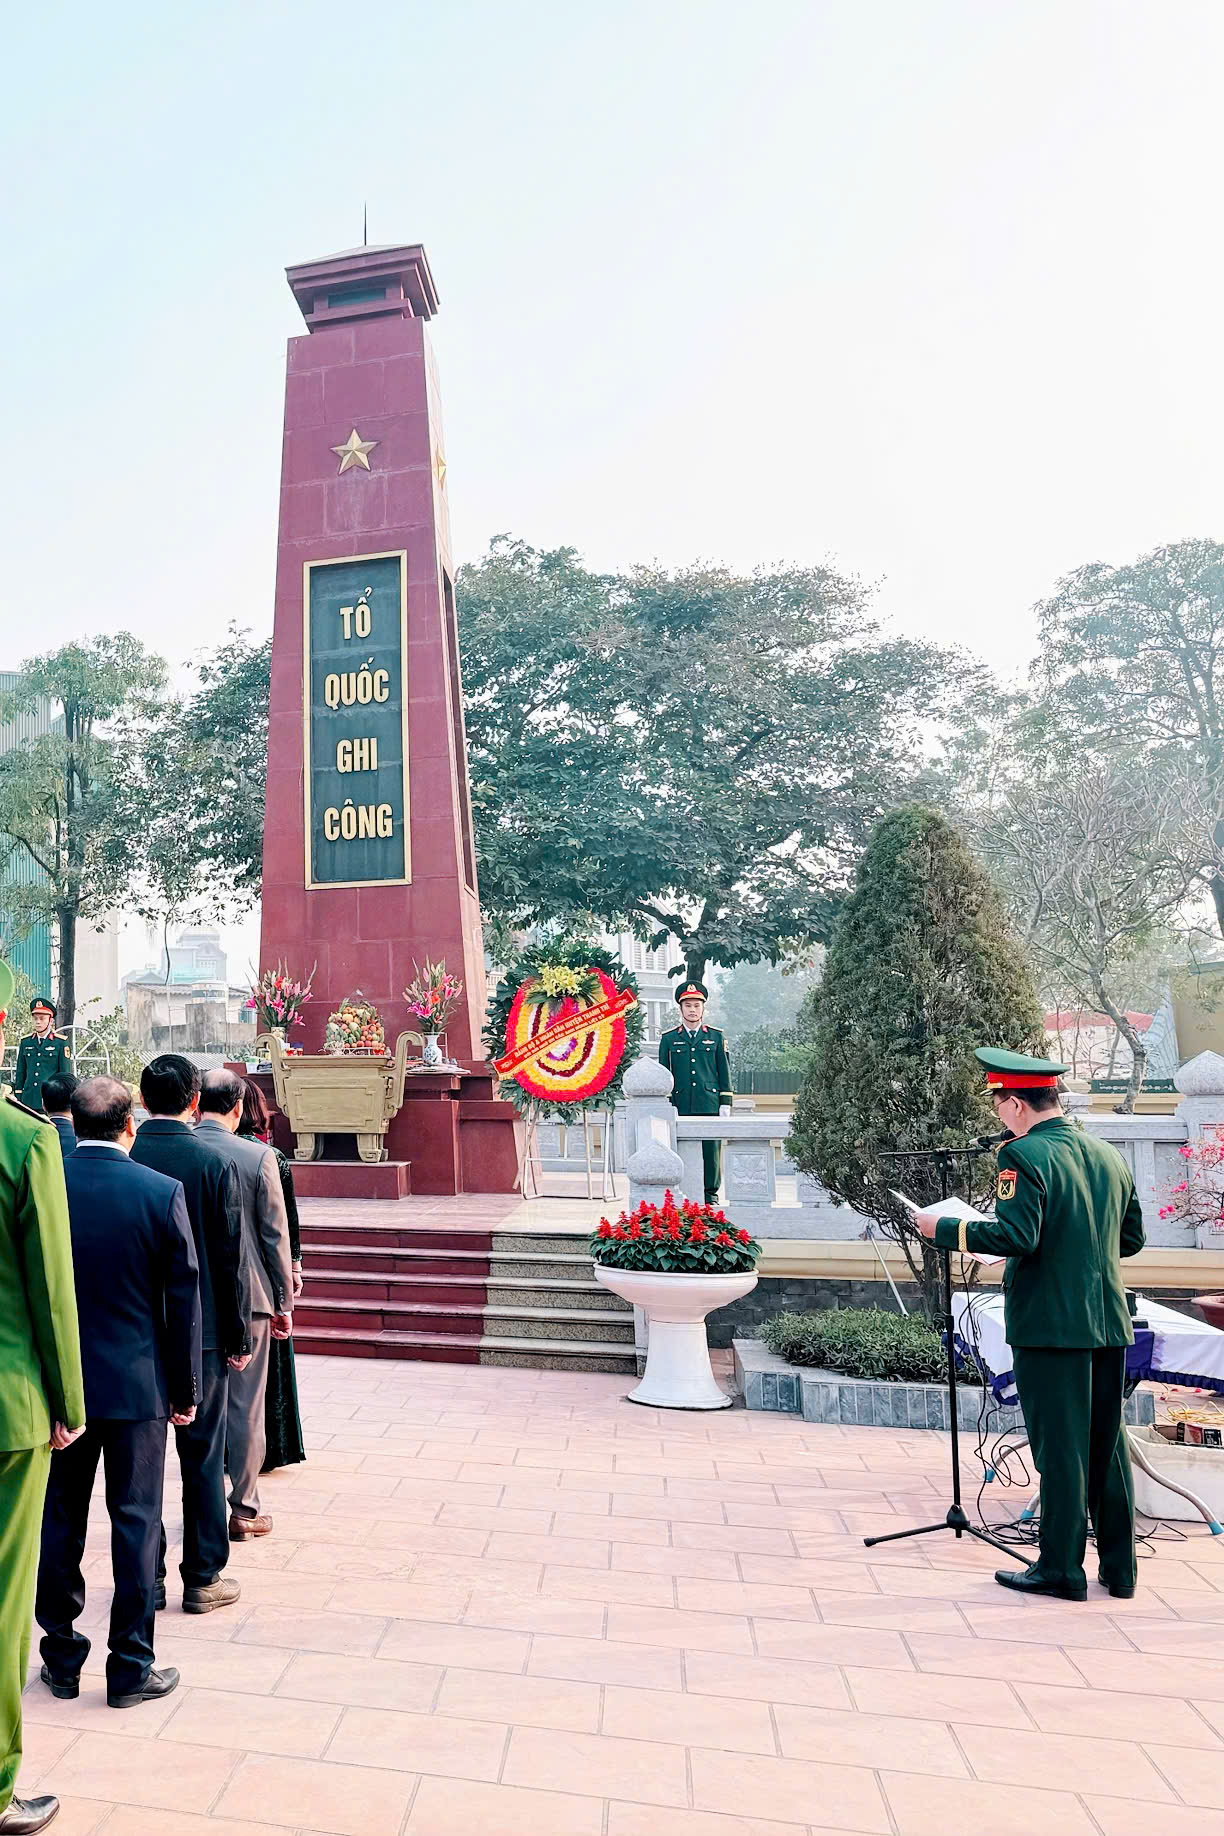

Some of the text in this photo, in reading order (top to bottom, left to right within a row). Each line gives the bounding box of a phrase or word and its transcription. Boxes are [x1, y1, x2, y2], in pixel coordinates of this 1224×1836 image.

[339, 586, 373, 640] TỔ
[324, 656, 390, 711] QUỐC
[336, 737, 378, 774] GHI
[323, 798, 393, 842] CÔNG
